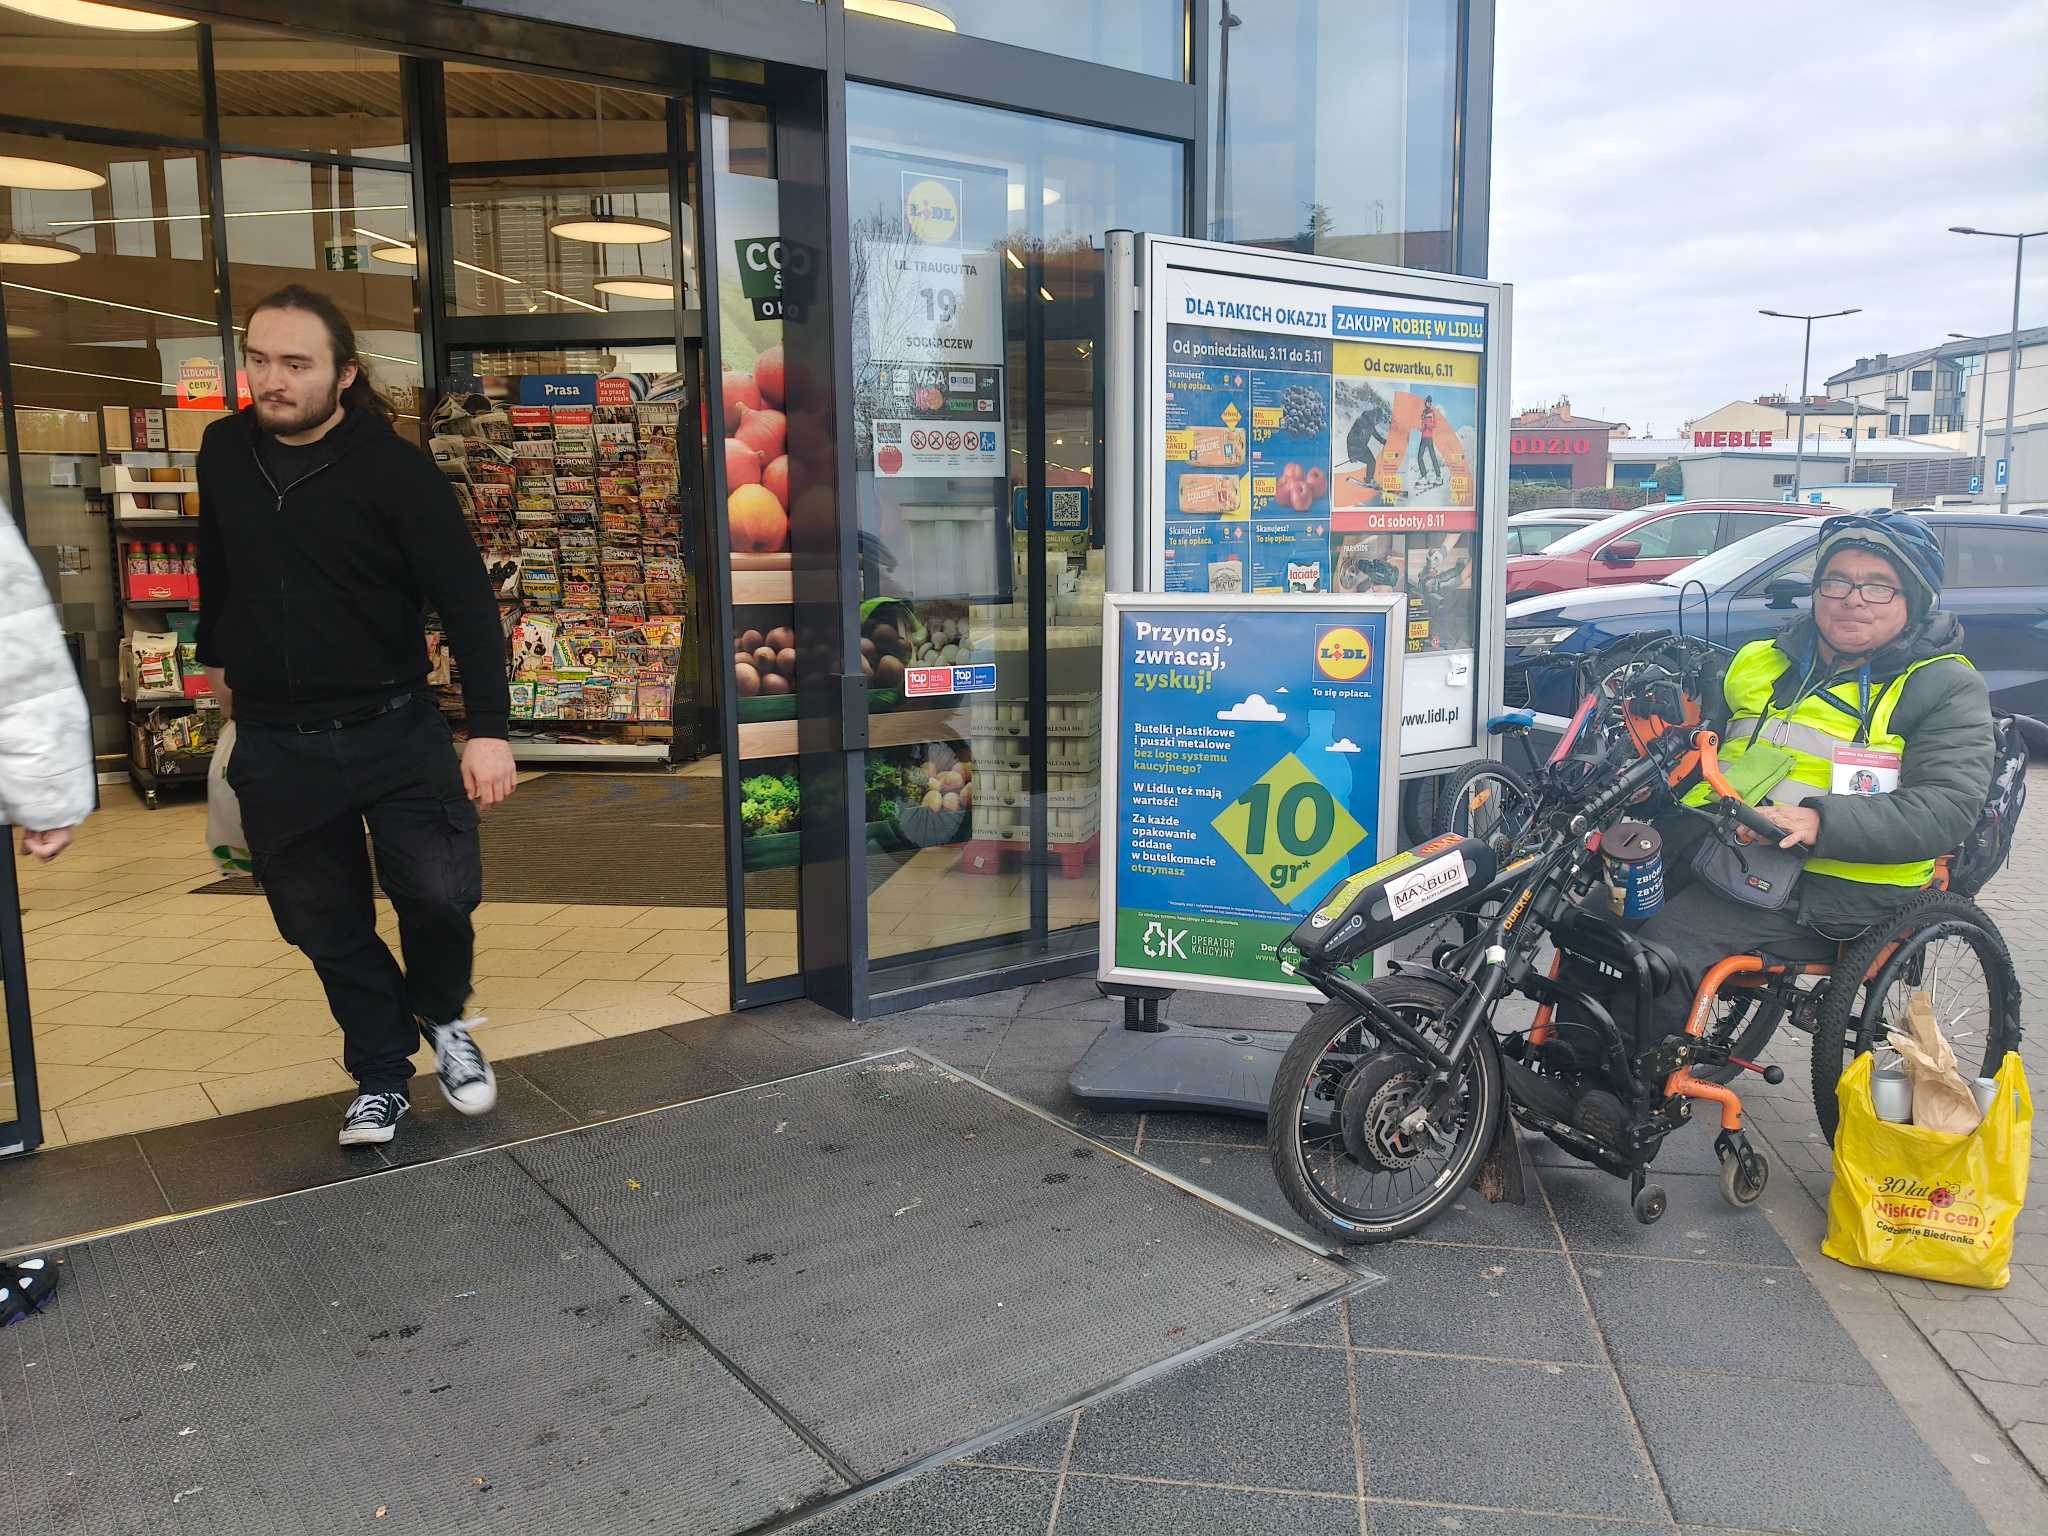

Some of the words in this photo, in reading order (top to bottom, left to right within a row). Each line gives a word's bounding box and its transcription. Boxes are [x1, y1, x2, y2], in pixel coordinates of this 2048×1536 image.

[920, 288, 957, 322] 19
[1185, 297, 1215, 317] DLA
[1217, 301, 1272, 322] TAKICH
[1276, 308, 1327, 328] OKAZJI
[1336, 313, 1391, 333] ZAKUPY
[1392, 318, 1432, 339] ROBIĘ
[1434, 321, 1446, 337] W
[1448, 322, 1483, 338] LIDLU
[1172, 340, 1190, 354] Od
[1193, 342, 1268, 362] poniedziałku,
[1269, 347, 1287, 361] 3.11
[1289, 348, 1303, 362] do
[1305, 350, 1322, 363] 5.11
[1364, 358, 1381, 373] Od
[1383, 361, 1434, 377] czwartku,
[1436, 364, 1453, 377] 6.11
[189, 380, 212, 390] ceny
[544, 384, 580, 395] Prasa
[1695, 431, 1773, 447] MEBLE
[1368, 514, 1386, 528] Od
[1387, 514, 1425, 530] soboty,
[1427, 513, 1445, 527] 8.11
[1135, 621, 1233, 647] Przynoś,
[1134, 646, 1226, 671] zwracaj,
[909, 672, 927, 685] top
[954, 669, 972, 681] top
[1134, 669, 1212, 694] zyskuj!
[1312, 687, 1322, 696] To
[1324, 688, 1337, 699] się
[1338, 689, 1372, 699] opłaca.
[1134, 723, 1173, 735] Butelki
[1175, 726, 1236, 738] plastikowe
[1140, 737, 1175, 748] puszki
[1177, 739, 1232, 750] metalowe
[1134, 748, 1152, 758] bez
[1155, 749, 1179, 760] logo
[1182, 752, 1228, 763] systemu
[1133, 760, 1202, 774] kaucyjnego?
[1133, 782, 1145, 792] W
[1147, 783, 1174, 794] Lidlu
[1177, 786, 1193, 797] też
[1195, 787, 1222, 800] mają
[1132, 796, 1179, 807] wartość!
[1132, 814, 1146, 824] Za
[1147, 815, 1180, 826] każde
[1238, 782, 1335, 856] 10
[1132, 827, 1197, 840] opakowanie
[1131, 840, 1173, 850] oddane
[1131, 851, 1141, 860] w
[1142, 852, 1217, 867] butelkomacie
[1131, 863, 1185, 876] otrzymasz
[1395, 869, 1457, 905] MAXBUD
[1503, 888, 1533, 930] QUICKIE
[1191, 936, 1235, 949] OPERATOR
[1191, 944, 1234, 958] KAUCYJNY
[1878, 1176, 1906, 1193] 30
[1905, 1181, 1930, 1197] lat
[1944, 1211, 1980, 1227] cen
[1923, 1229, 1975, 1245] Biedronka
